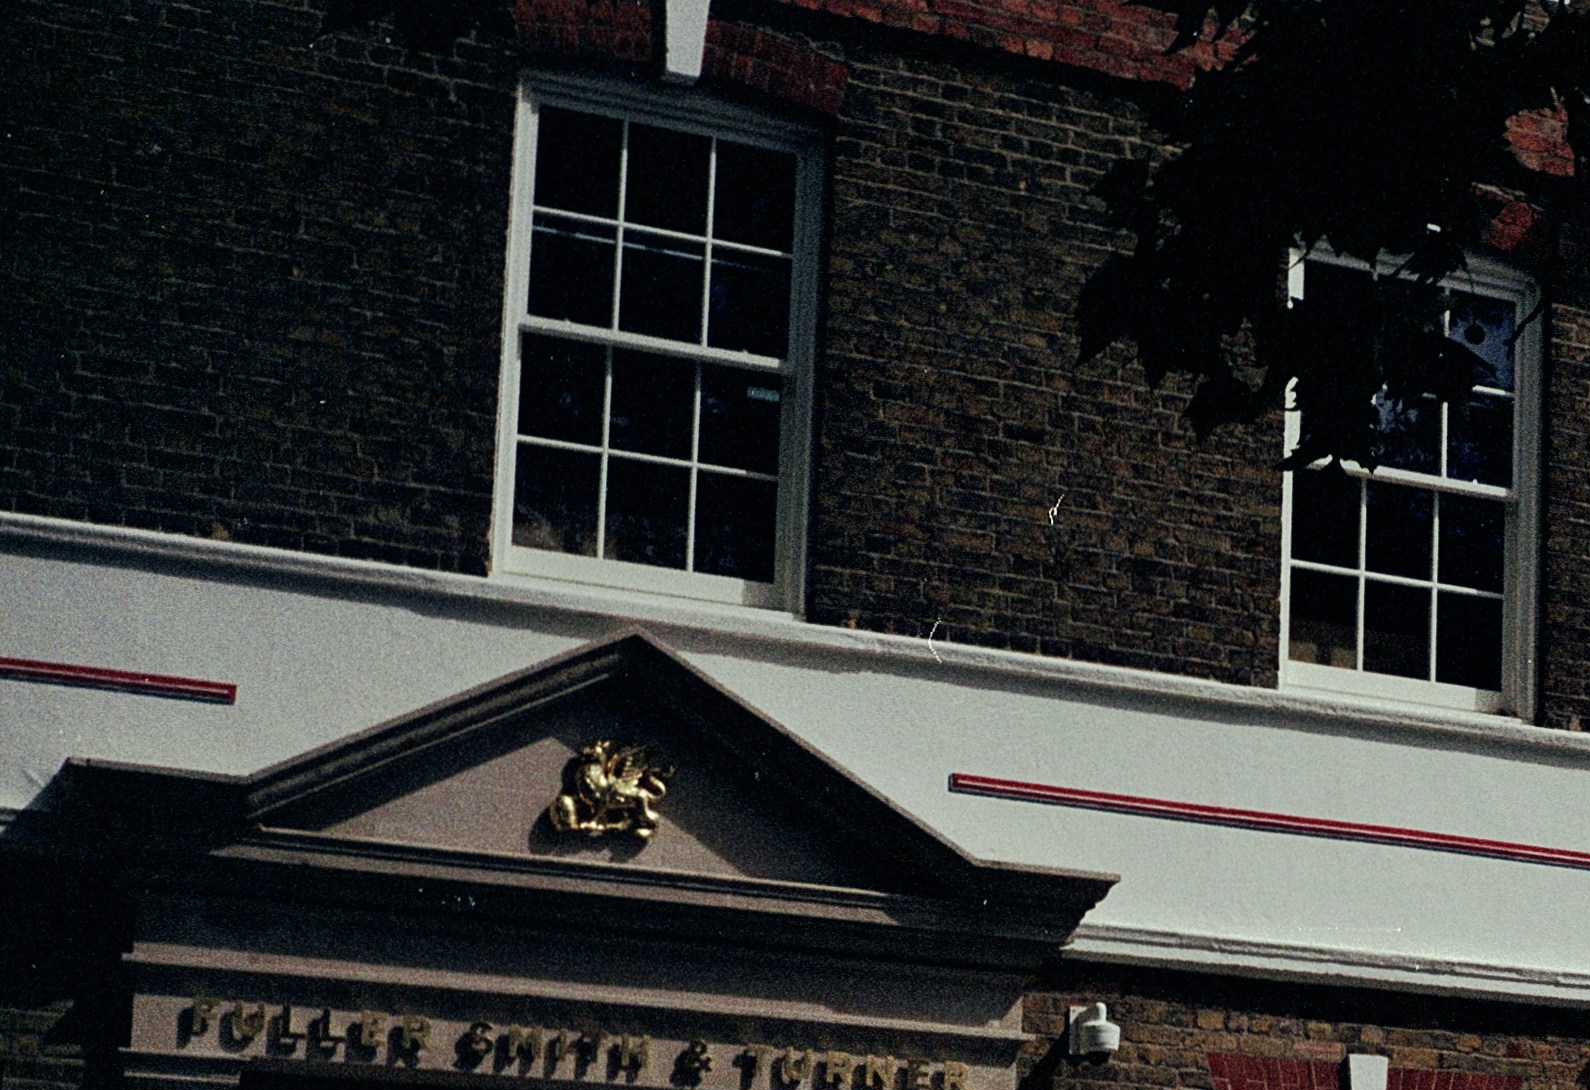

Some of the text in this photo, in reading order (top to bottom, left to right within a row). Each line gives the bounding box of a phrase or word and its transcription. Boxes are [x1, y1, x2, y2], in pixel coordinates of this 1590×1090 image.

[188, 998, 432, 1056] FULLER
[464, 1021, 651, 1074] SMITH
[675, 1038, 712, 1082] &
